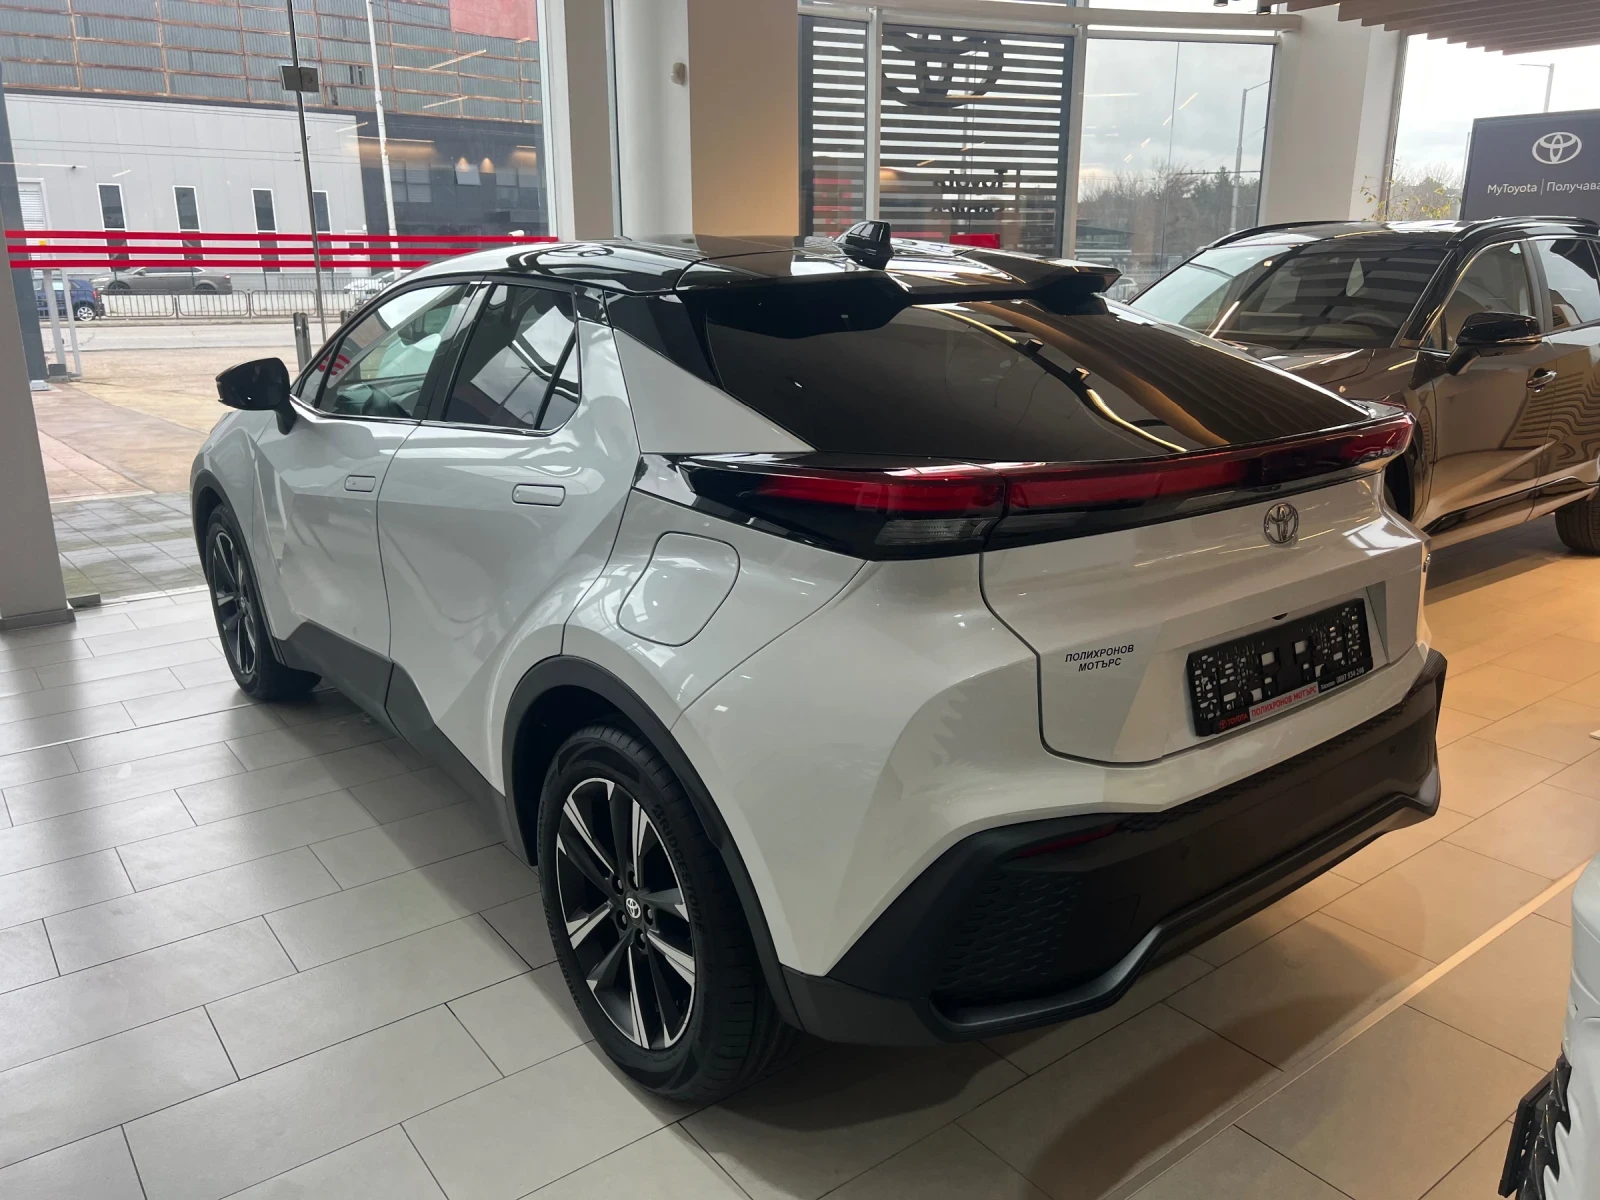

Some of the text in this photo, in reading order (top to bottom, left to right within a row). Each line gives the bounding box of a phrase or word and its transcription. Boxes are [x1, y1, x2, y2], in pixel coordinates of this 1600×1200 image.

[1487, 183, 1538, 196] MyToyota
[1065, 644, 1134, 662] ПОЛИХРОНОВ
[1078, 657, 1121, 672] МОТЪРС
[1250, 685, 1317, 717] ПОЛИХРОНОВ МОТЪРС
[1227, 713, 1248, 725] TOYOTA
